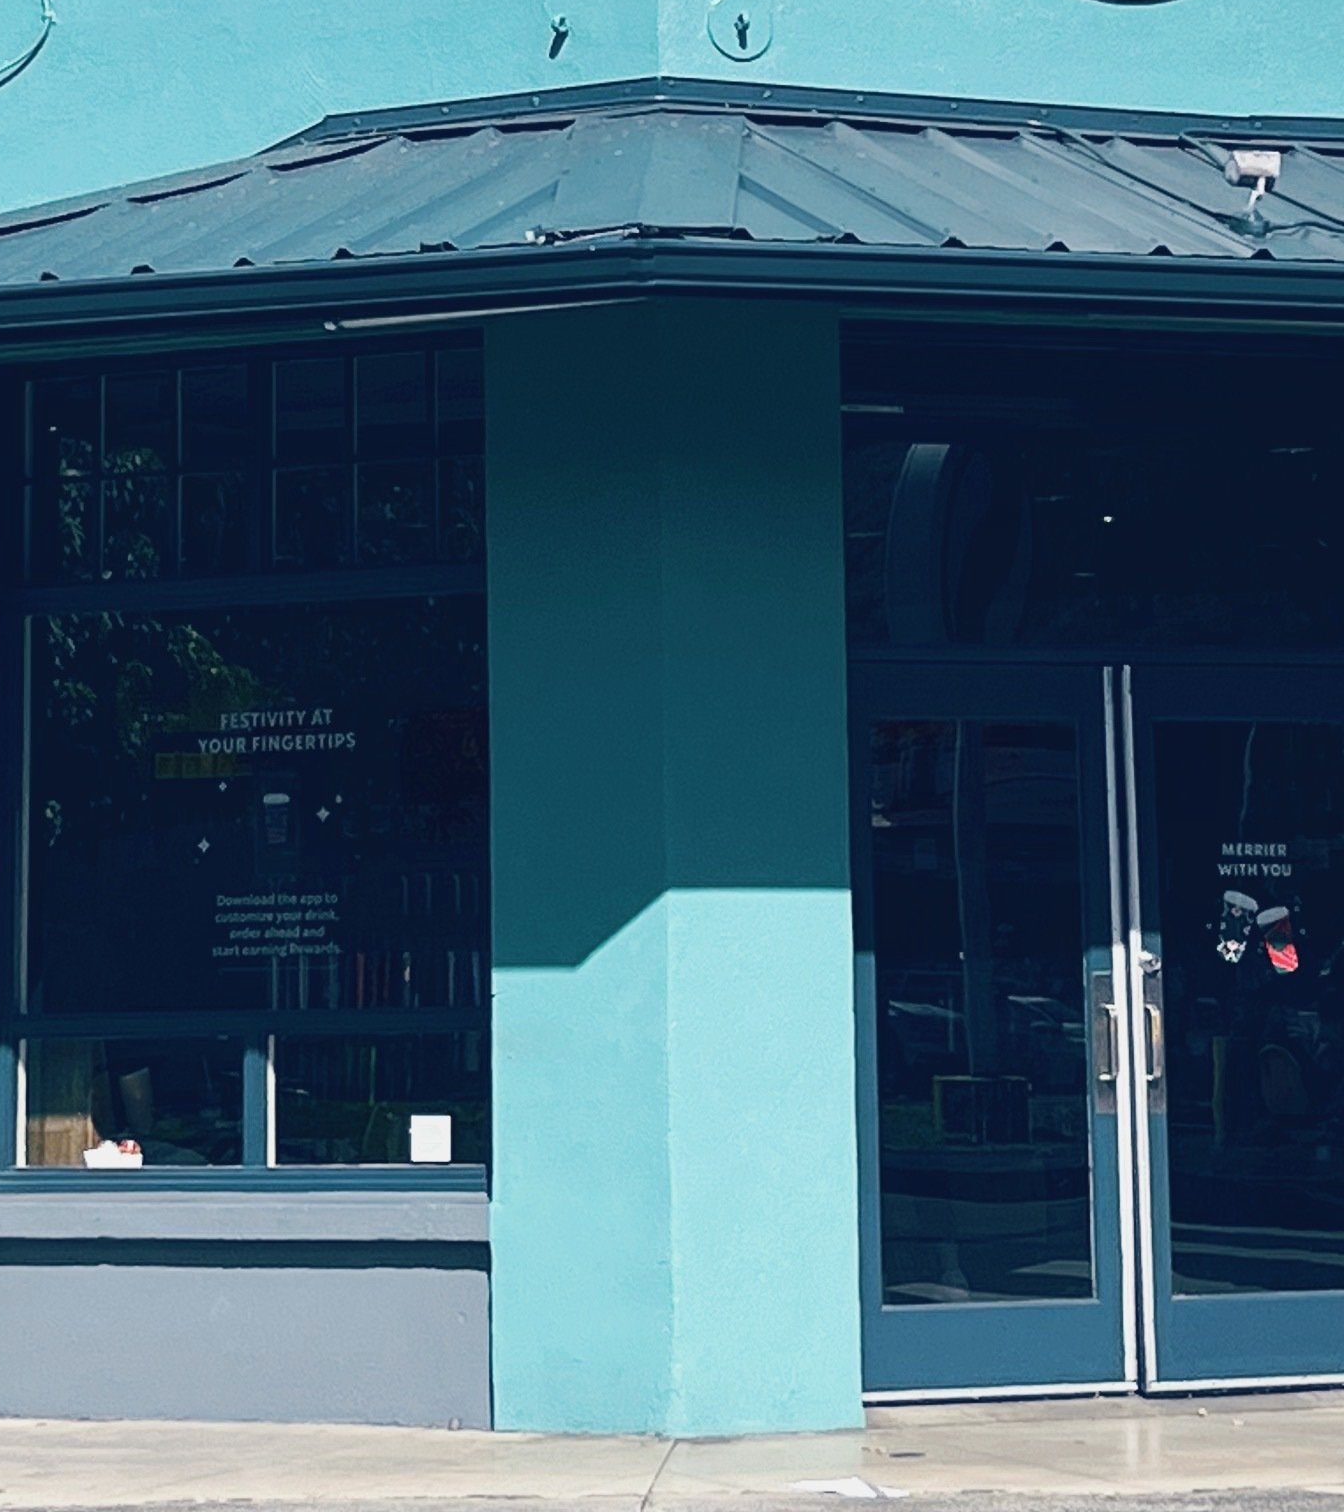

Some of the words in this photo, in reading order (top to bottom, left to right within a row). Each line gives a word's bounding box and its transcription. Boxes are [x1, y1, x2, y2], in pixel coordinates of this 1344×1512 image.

[219, 710, 307, 730] FESTIVITY
[310, 708, 333, 726] AT
[197, 737, 247, 754] YOUR
[252, 731, 357, 752] FINGERTIPS
[1221, 842, 1287, 857] MERRIER
[1216, 863, 1258, 877] WITH
[1260, 863, 1293, 877] YOU
[215, 893, 275, 907] Download
[277, 892, 297, 905] the
[299, 894, 323, 908] app
[324, 892, 339, 904] to
[214, 912, 274, 924] customize
[275, 911, 302, 924] your
[229, 927, 261, 939] order
[264, 925, 300, 939] ahead
[302, 925, 326, 938] and
[212, 944, 239, 957] start
[241, 944, 287, 958] earning
